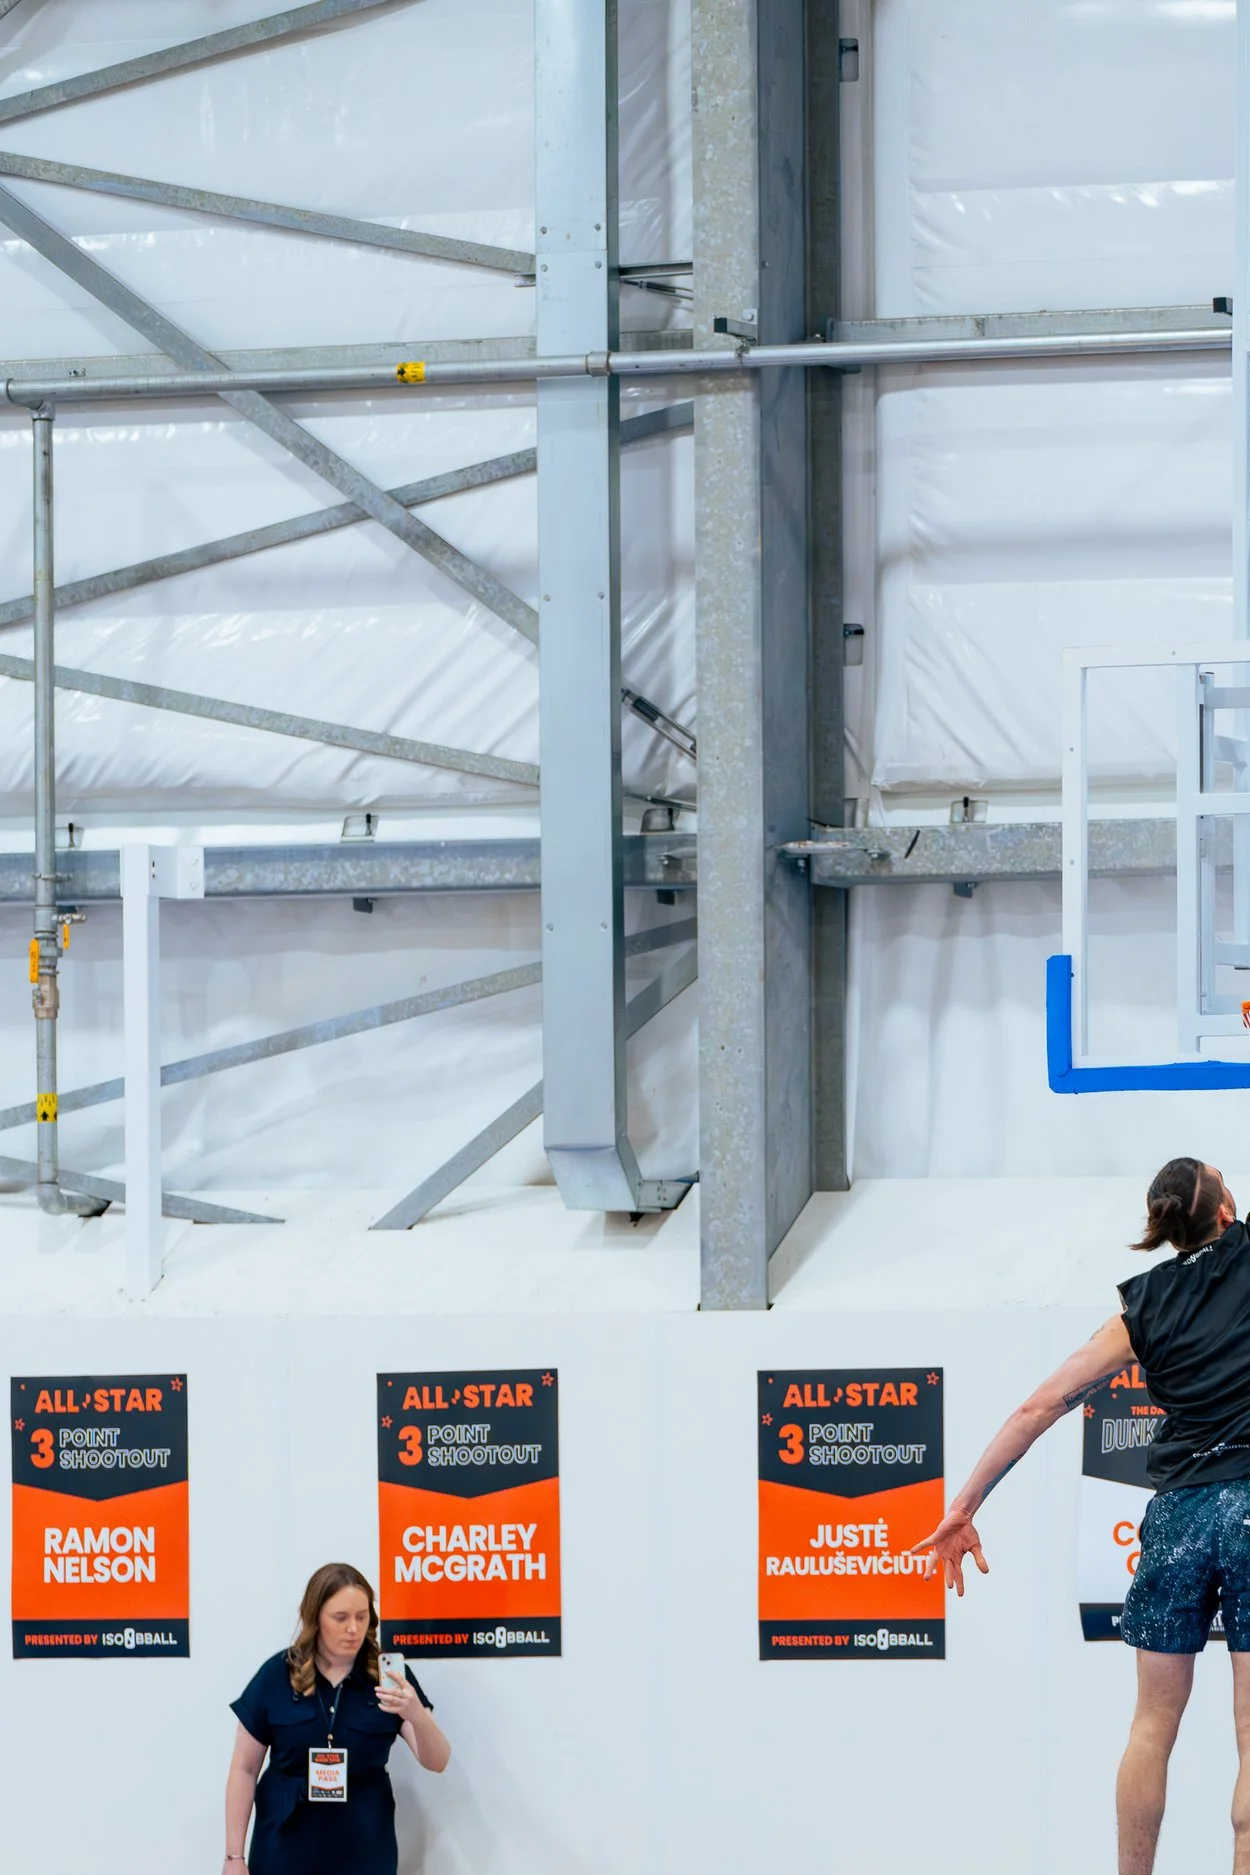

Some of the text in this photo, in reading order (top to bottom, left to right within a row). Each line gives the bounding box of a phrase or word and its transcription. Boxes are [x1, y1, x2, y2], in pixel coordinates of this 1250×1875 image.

[1110, 1364, 1147, 1389] AL
[34, 1388, 163, 1413] ALL STAR
[402, 1383, 533, 1410] ALL STAR
[782, 1382, 918, 1408] ALL STAR
[1130, 1406, 1168, 1415] THE DA
[30, 1428, 120, 1469] 3 POINT
[398, 1423, 491, 1466] 3 POINT
[778, 1423, 874, 1465] 3 POINT
[1101, 1418, 1158, 1454] DUNK
[59, 1448, 171, 1469] SHOOTOUT
[427, 1444, 542, 1467] SHOOTOUT
[809, 1444, 927, 1466] SHOOTOUT
[44, 1526, 155, 1554] RAMON
[402, 1523, 537, 1553] CHARLEY
[810, 1518, 888, 1548] JUSTĖ
[44, 1556, 156, 1583] NELSON
[394, 1553, 547, 1583] MCGRATH
[25, 1634, 84, 1646] PRESENTED
[84, 1634, 98, 1645] BY
[393, 1633, 453, 1645] PRESENTED
[453, 1633, 469, 1644] BY
[771, 1635, 833, 1646] PRESENTED
[833, 1635, 849, 1646] BY
